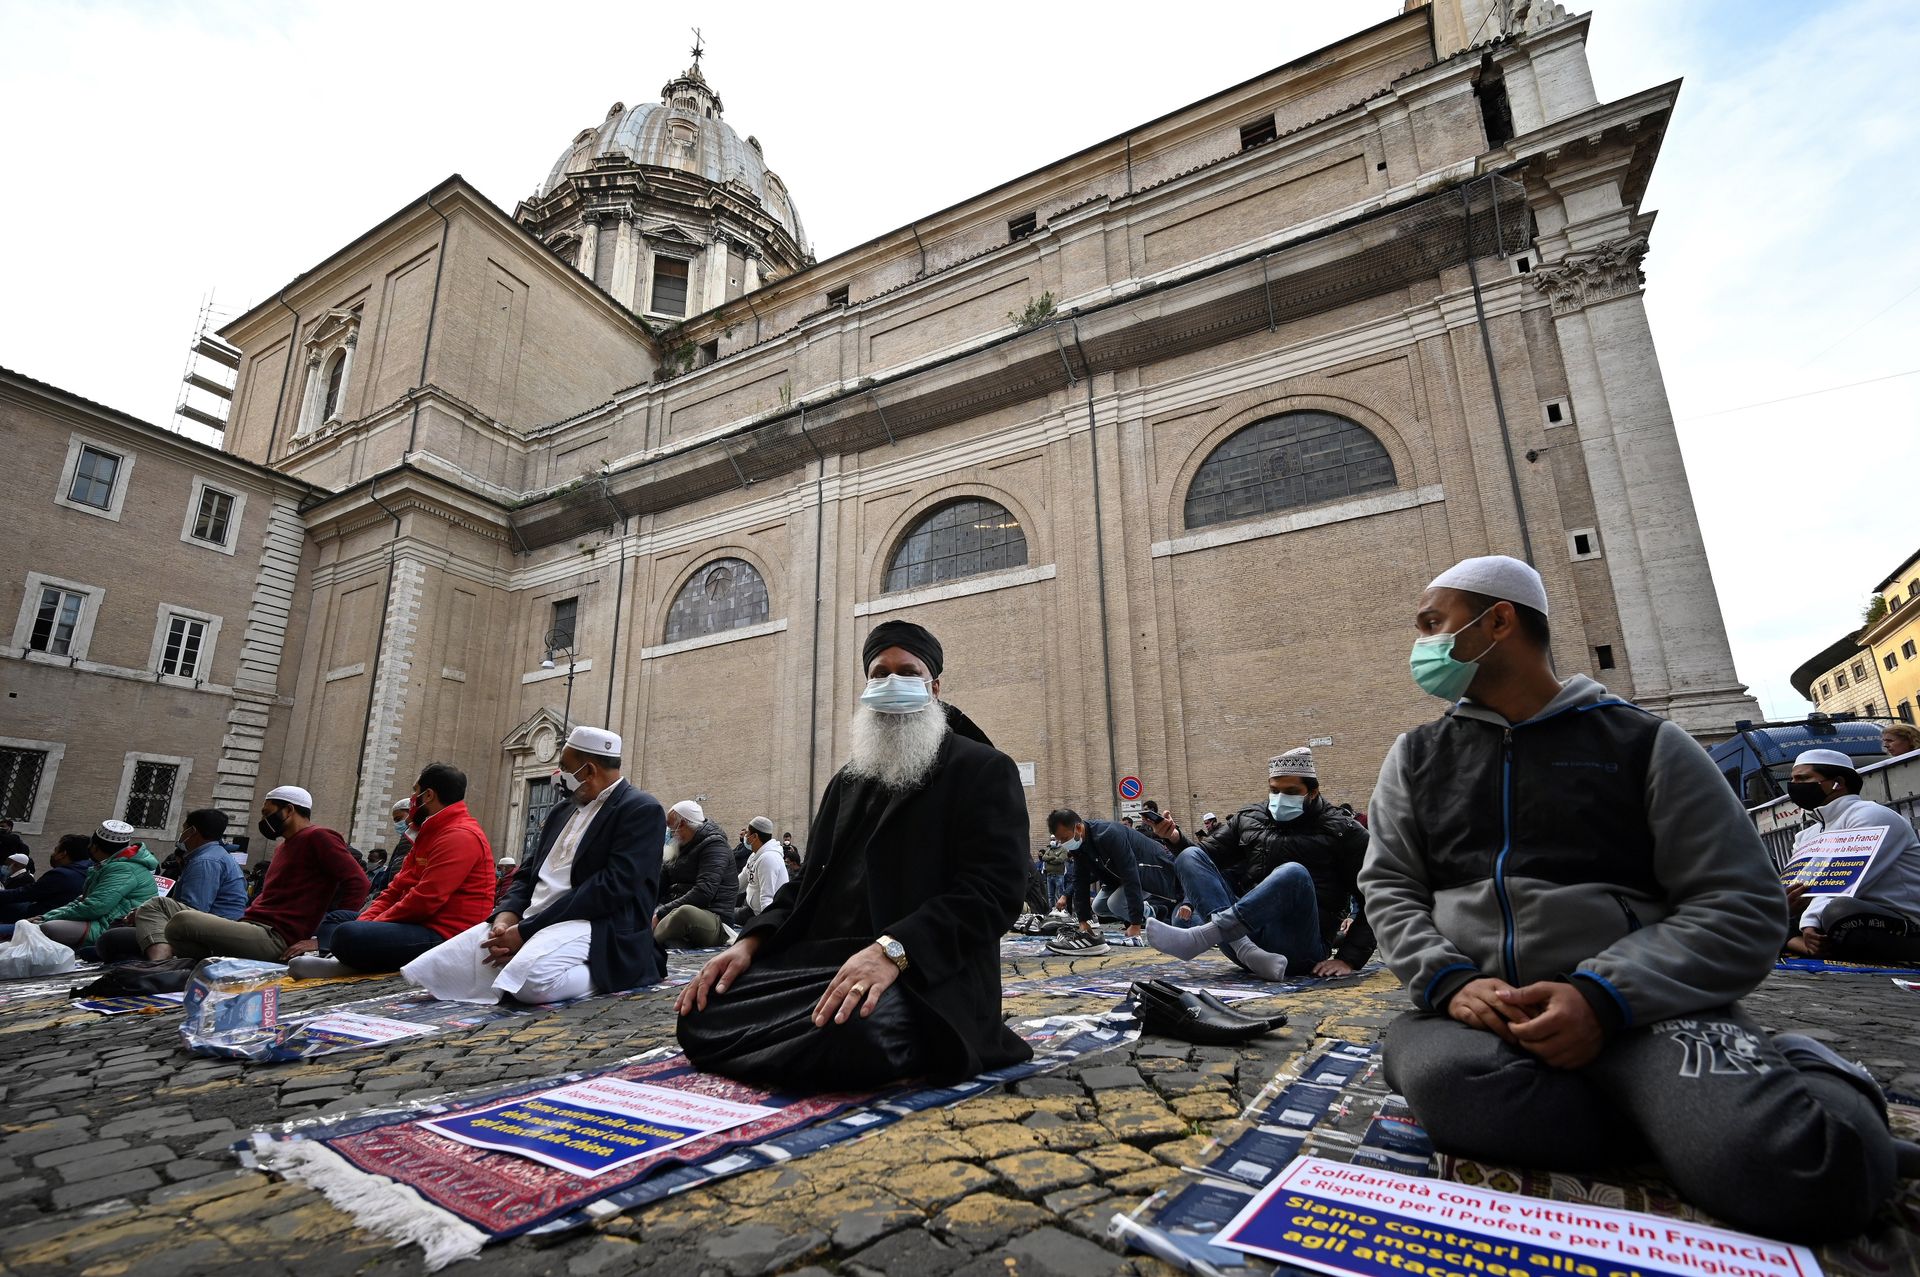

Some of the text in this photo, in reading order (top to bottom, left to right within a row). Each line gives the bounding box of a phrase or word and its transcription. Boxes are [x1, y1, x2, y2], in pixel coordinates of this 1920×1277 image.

[1282, 1230, 1348, 1253] agli
[1285, 1196, 1598, 1277] Siamo contrari alla
[1291, 1215, 1531, 1277] delle moschee
[1300, 1179, 1311, 1187] e
[1314, 1179, 1395, 1205] Rispetto
[1399, 1199, 1436, 1213] per
[1440, 1206, 1453, 1218] il
[1459, 1211, 1542, 1237] Profeta
[1548, 1230, 1562, 1240] e
[1568, 1234, 1611, 1250] per
[1617, 1240, 1640, 1257] la
[1308, 1165, 1788, 1267] Solidarietà con le vittime in Francia
